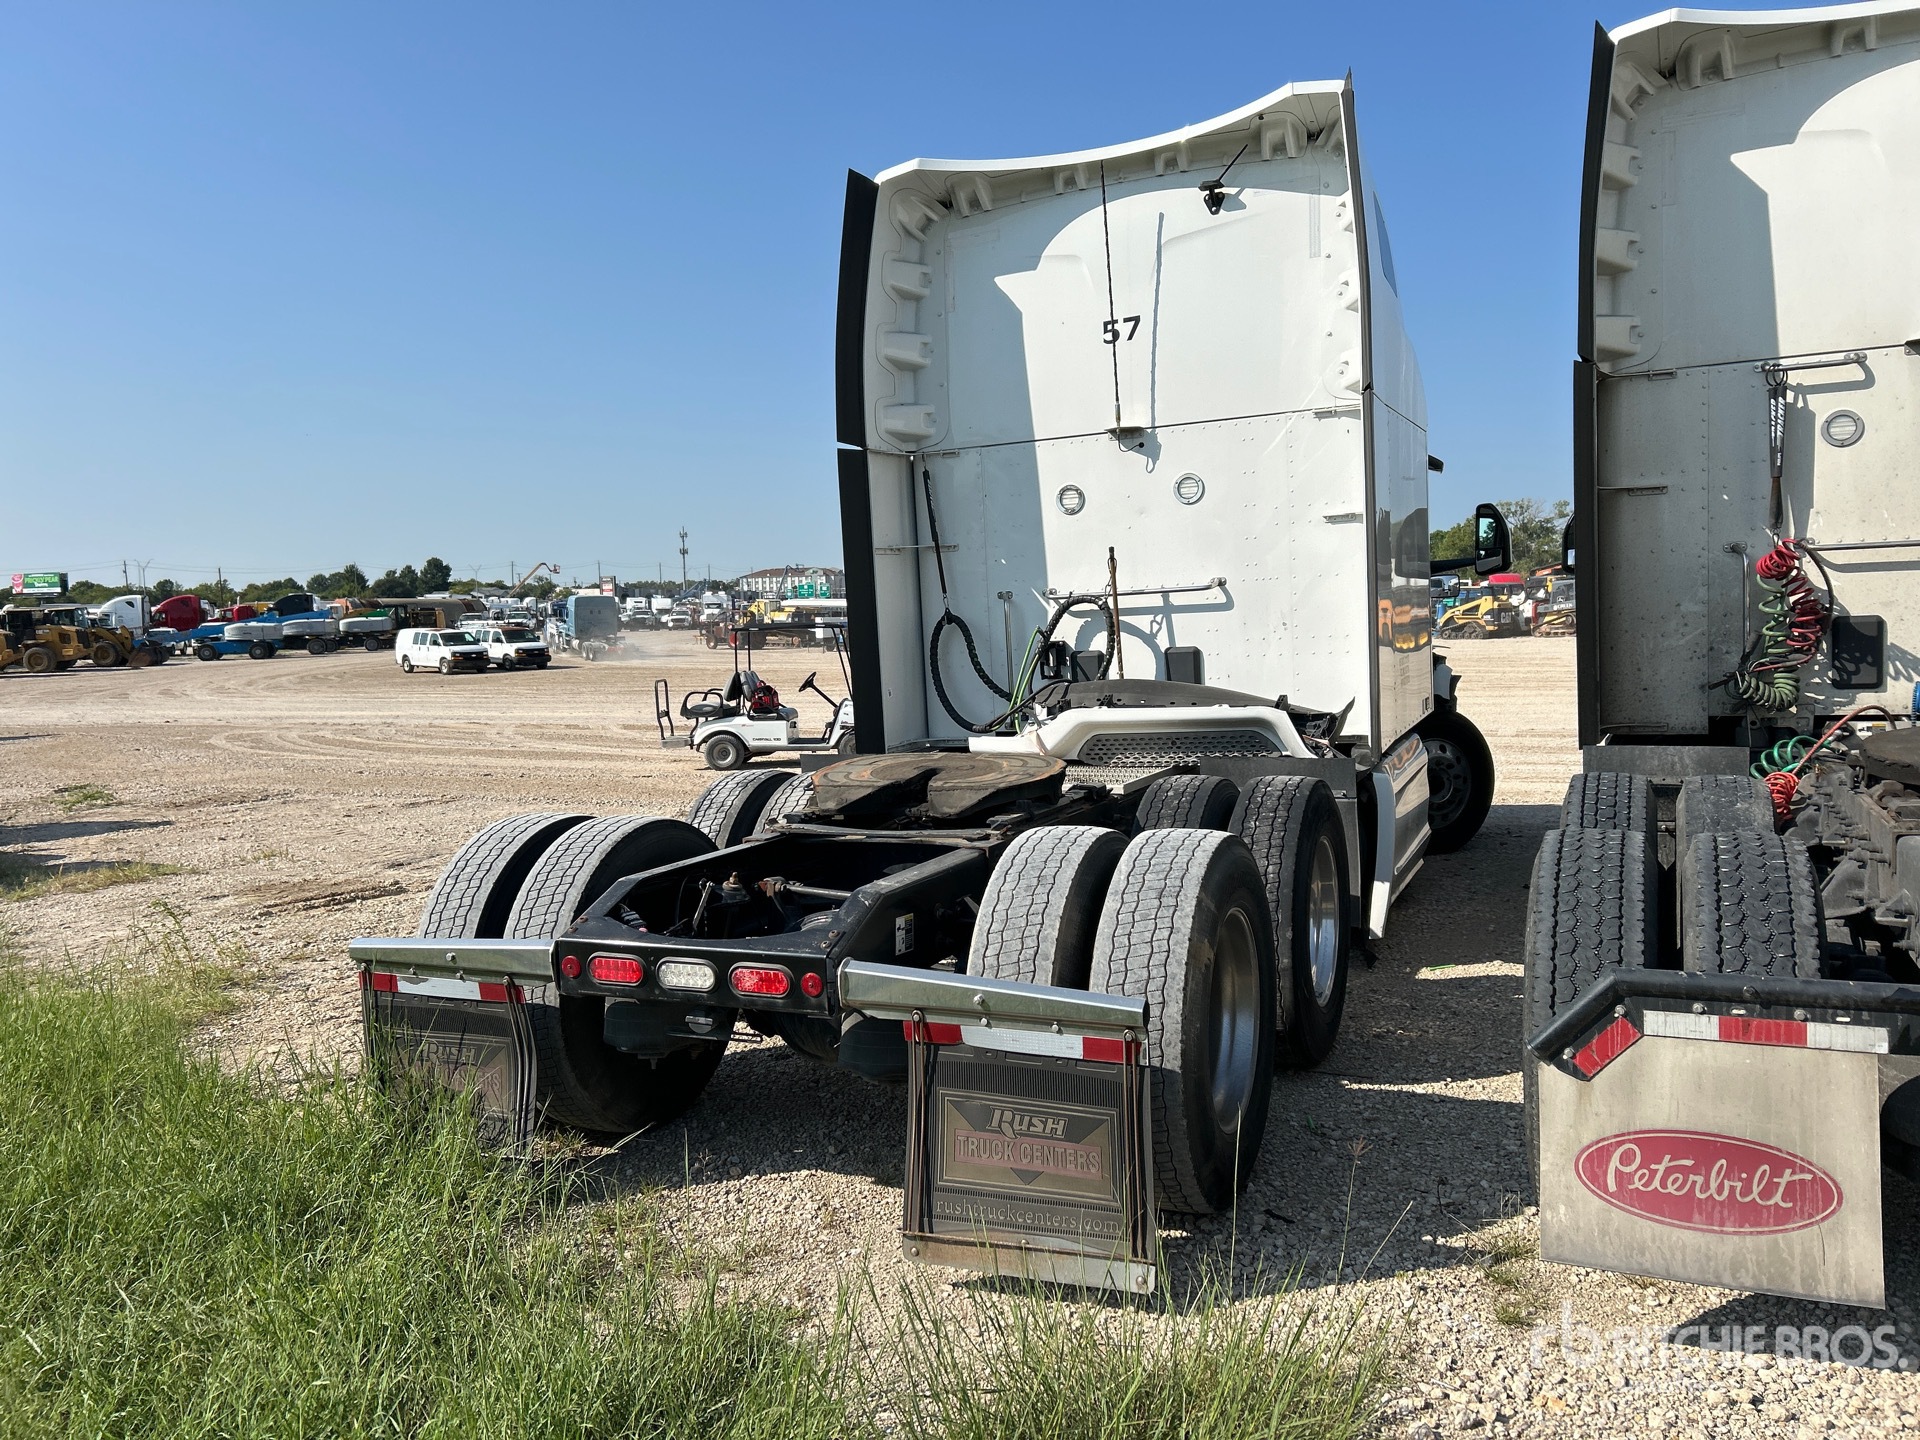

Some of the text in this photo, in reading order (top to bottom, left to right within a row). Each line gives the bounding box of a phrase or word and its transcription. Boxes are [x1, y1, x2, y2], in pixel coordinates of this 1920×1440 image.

[1103, 315, 1141, 344] 57
[1777, 396, 1785, 437] TRACKER
[987, 1105, 1069, 1140] RUSH
[957, 1135, 1101, 1174] TRUCK CENTERS
[1607, 1143, 1813, 1209] Peterbilt
[936, 1199, 1121, 1234] rushtruckcenters.com
